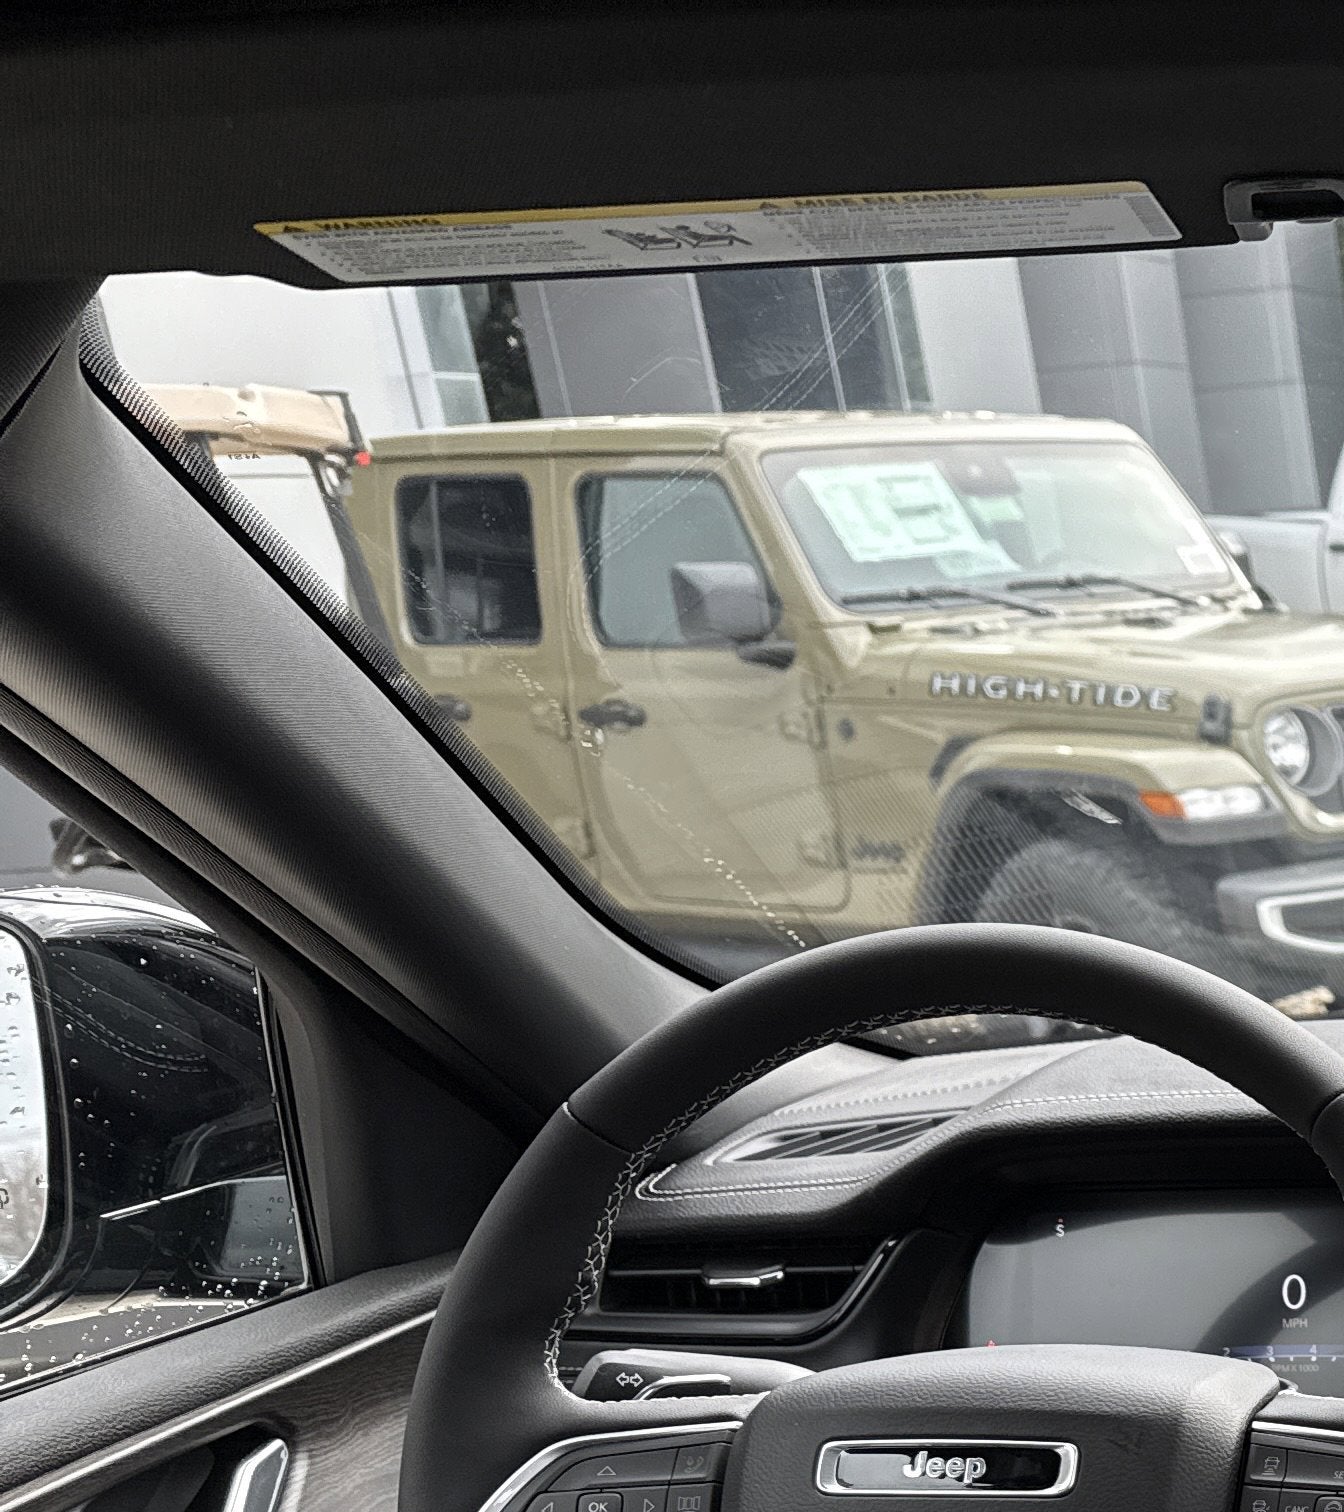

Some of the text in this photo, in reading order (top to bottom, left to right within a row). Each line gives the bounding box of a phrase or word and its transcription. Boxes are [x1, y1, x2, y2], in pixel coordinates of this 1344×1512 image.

[1282, 1274, 1307, 1310] 0
[1282, 1318, 1308, 1329] MPH
[1266, 1345, 1274, 1356] 3
[1309, 1344, 1318, 1356] 4
[902, 1451, 987, 1484] Jeep
[588, 1503, 608, 1512] OK
